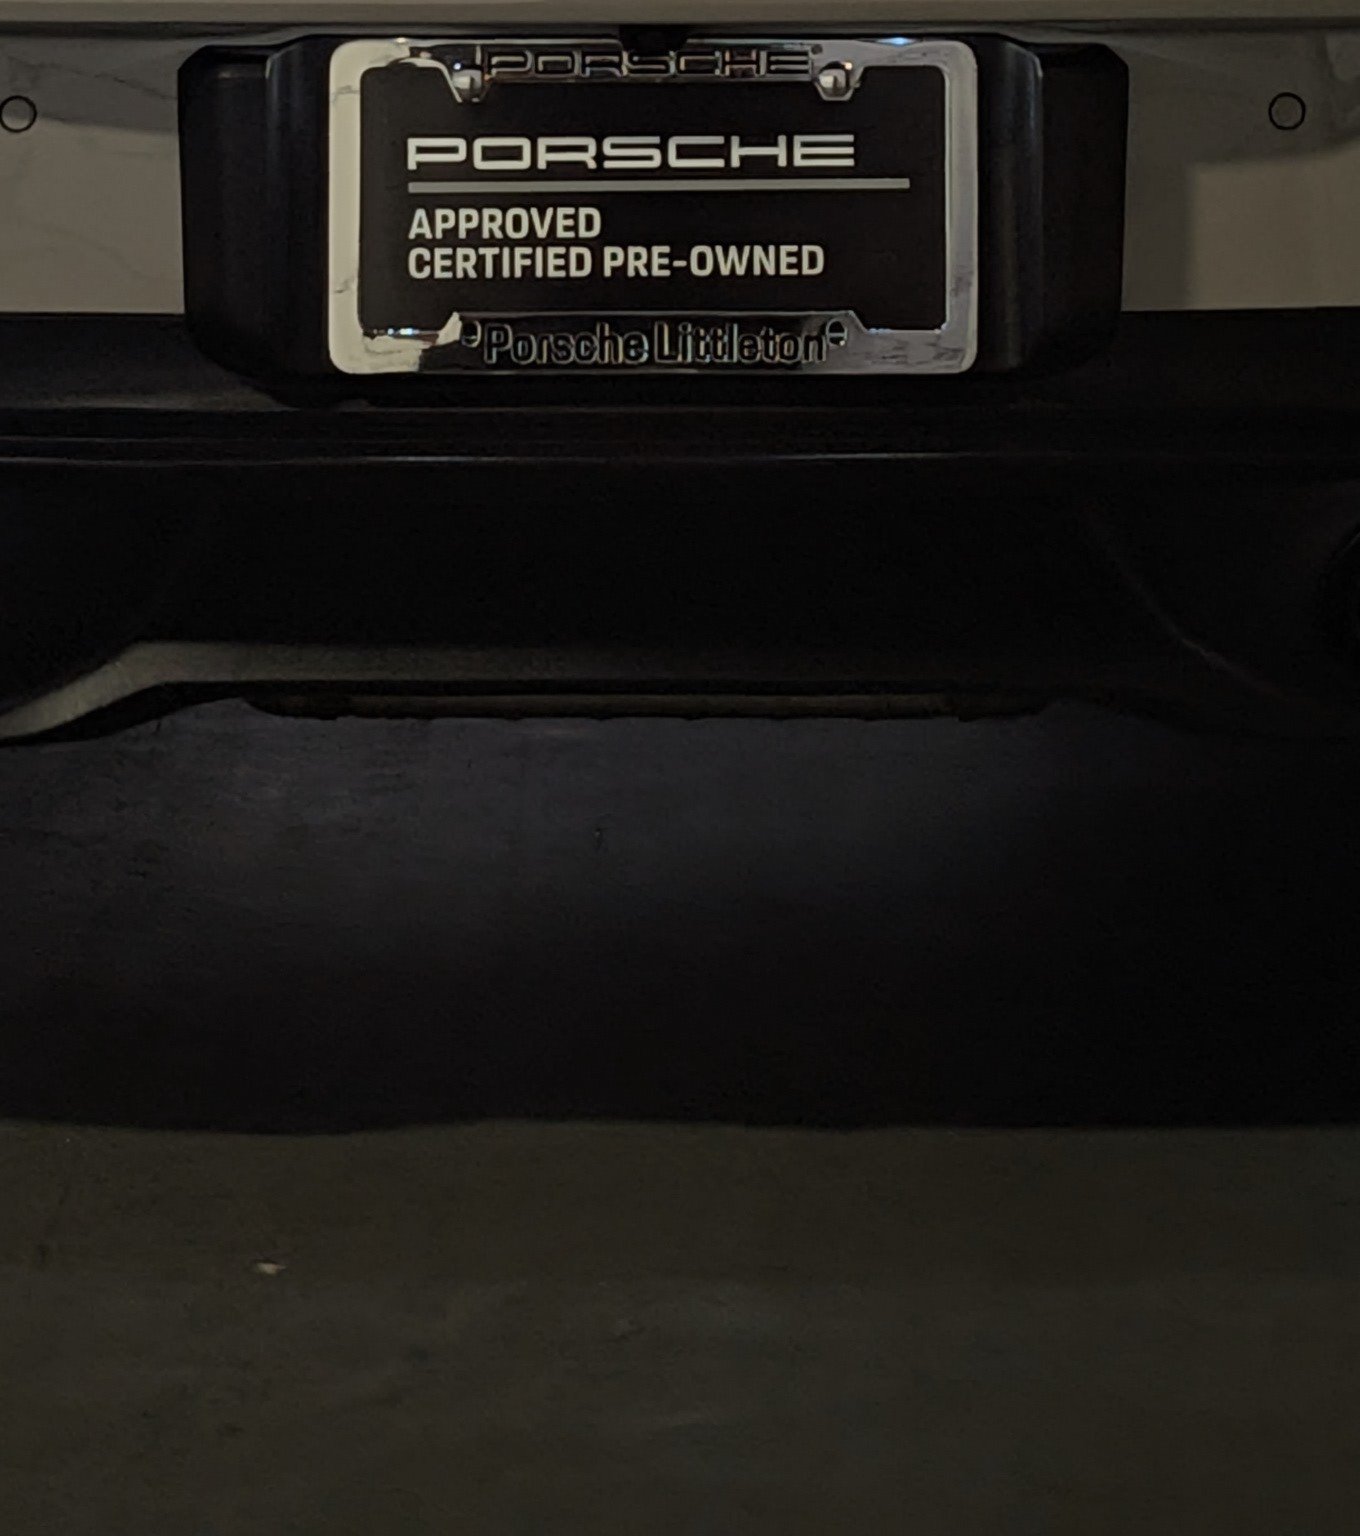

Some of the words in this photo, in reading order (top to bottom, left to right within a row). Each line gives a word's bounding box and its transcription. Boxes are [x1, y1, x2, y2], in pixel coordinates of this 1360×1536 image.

[482, 48, 813, 80] PORSCHE
[407, 134, 856, 170] PORSCHE
[408, 207, 602, 240] APPROVED
[407, 246, 592, 279] CERTIFIED
[603, 244, 825, 277] PRE-OWNED
[484, 322, 649, 365] Porsche
[653, 321, 827, 363] Littleton
